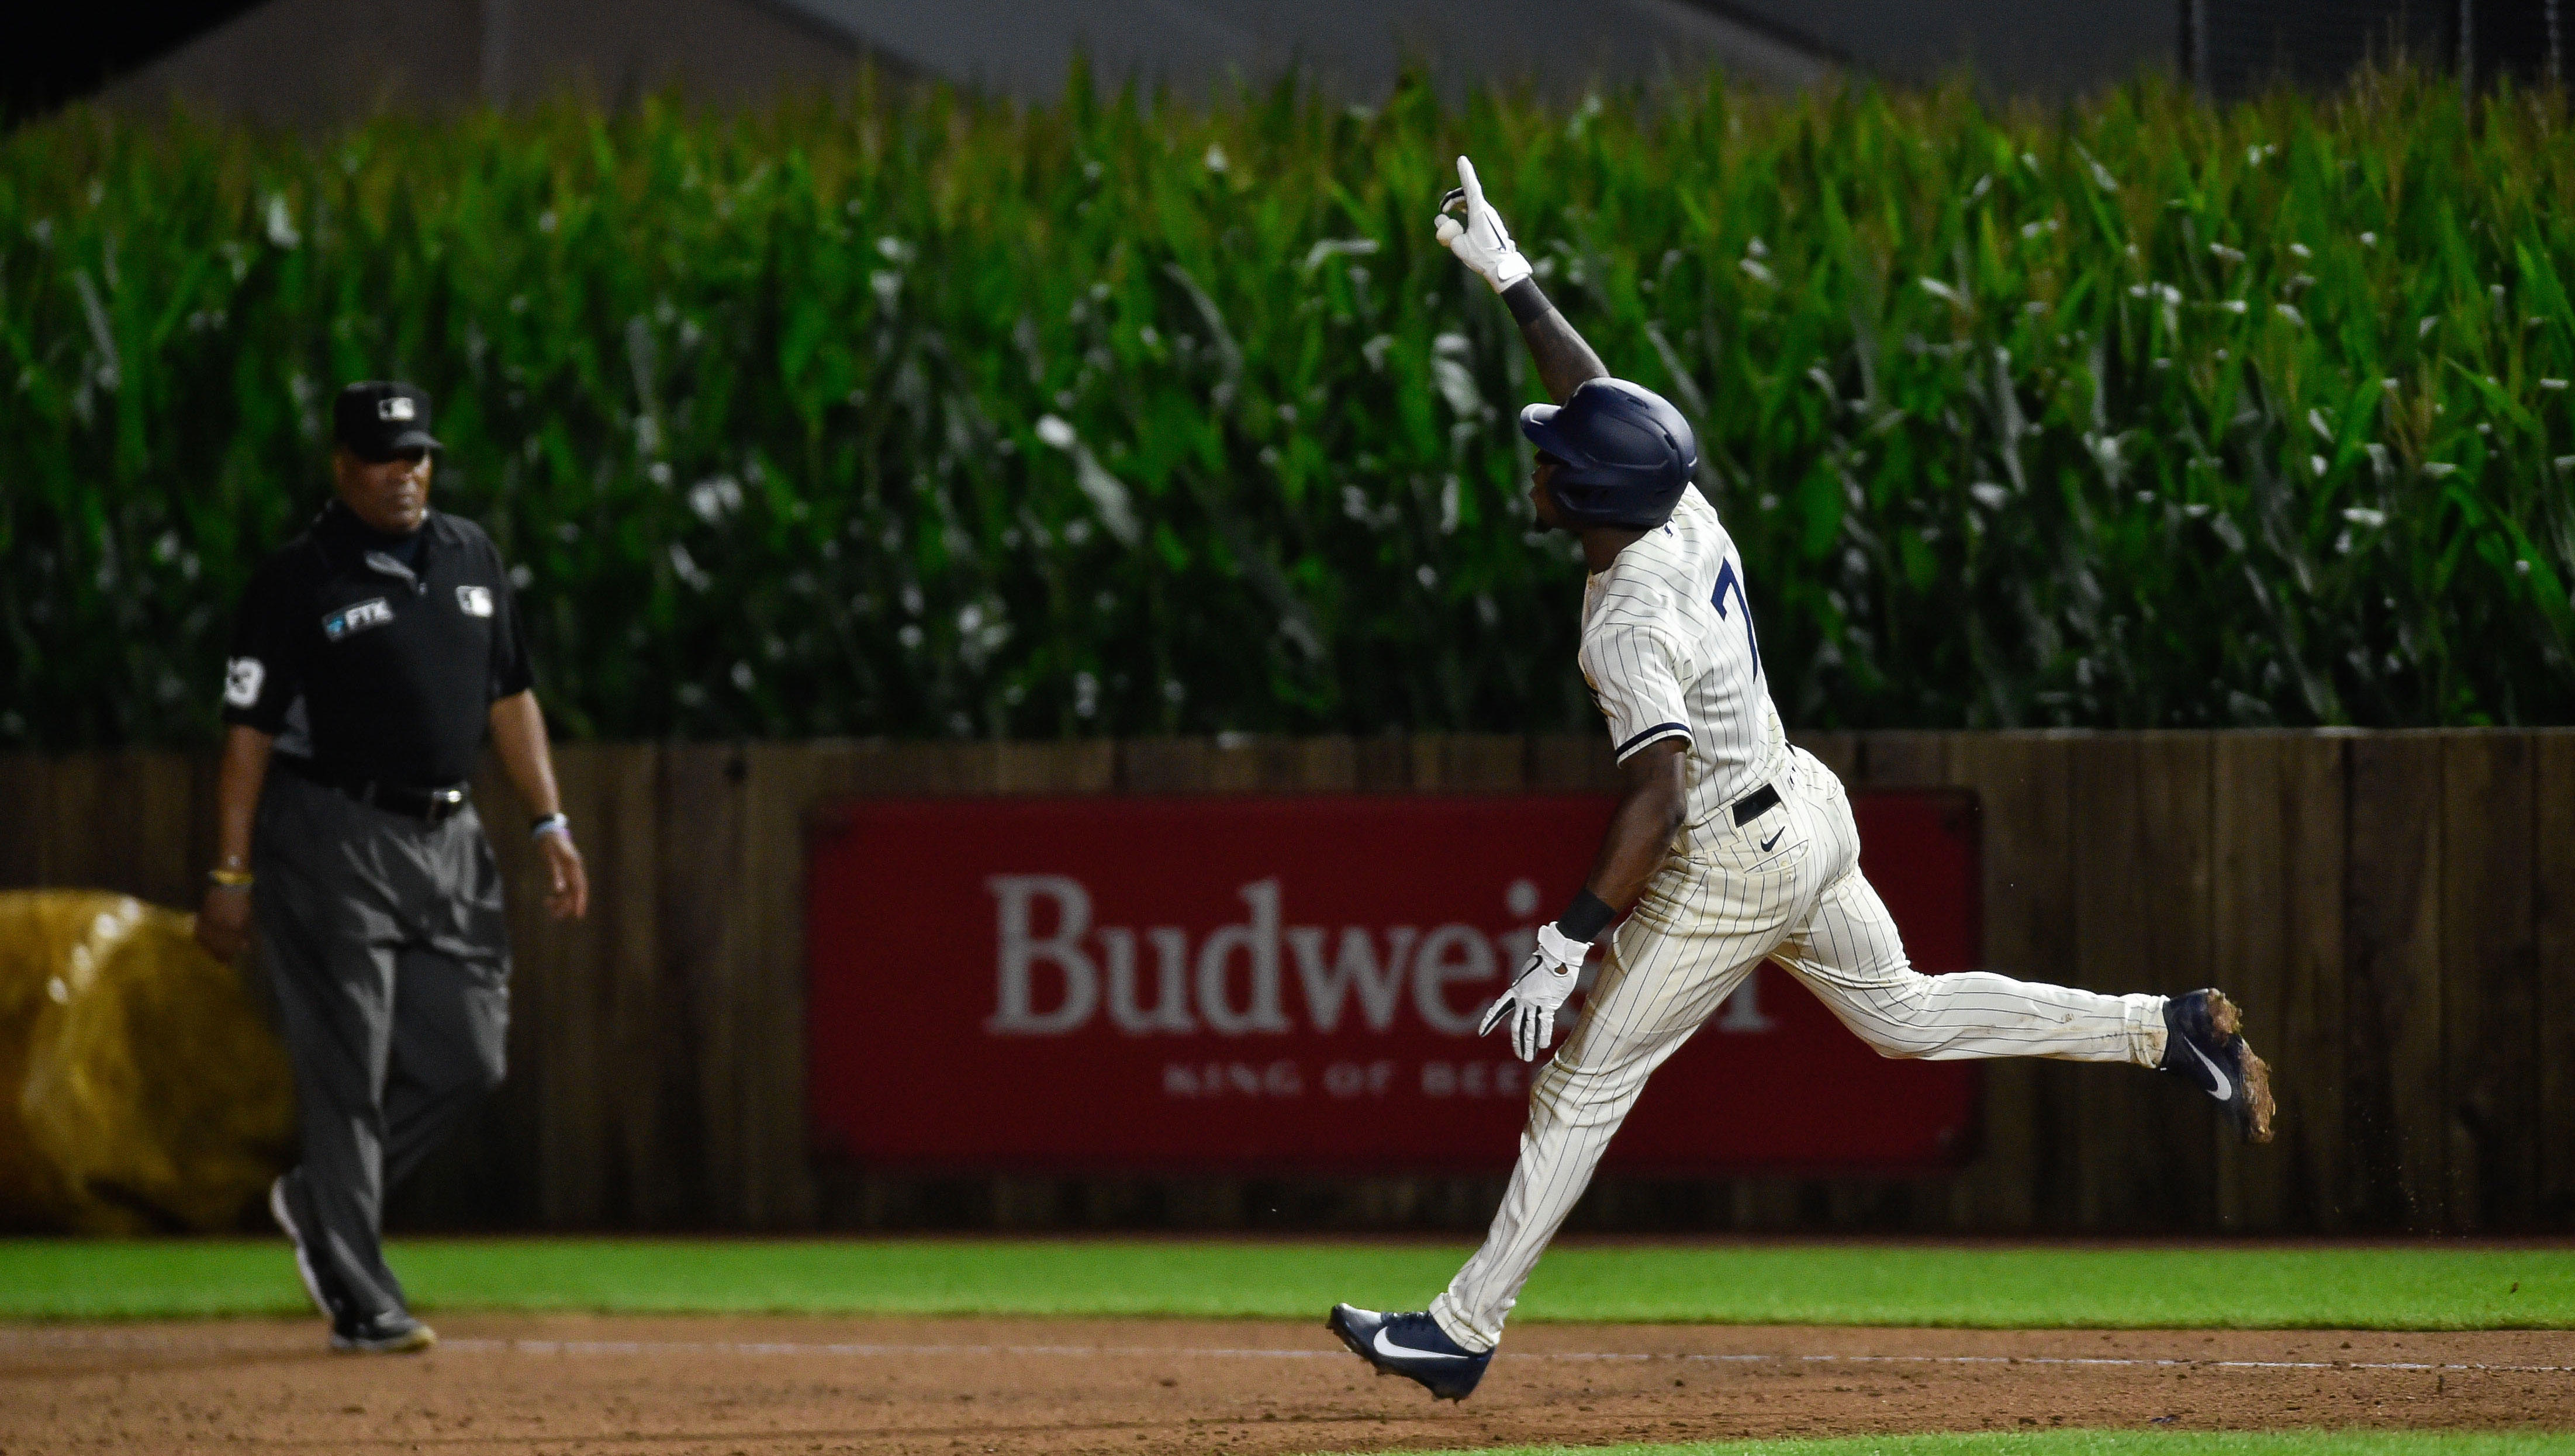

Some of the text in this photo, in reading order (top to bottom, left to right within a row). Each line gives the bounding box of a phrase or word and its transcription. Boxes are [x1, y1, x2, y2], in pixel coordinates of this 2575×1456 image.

[1710, 556, 1759, 684] 7
[1164, 1059, 1548, 1098] KING OF BEE
